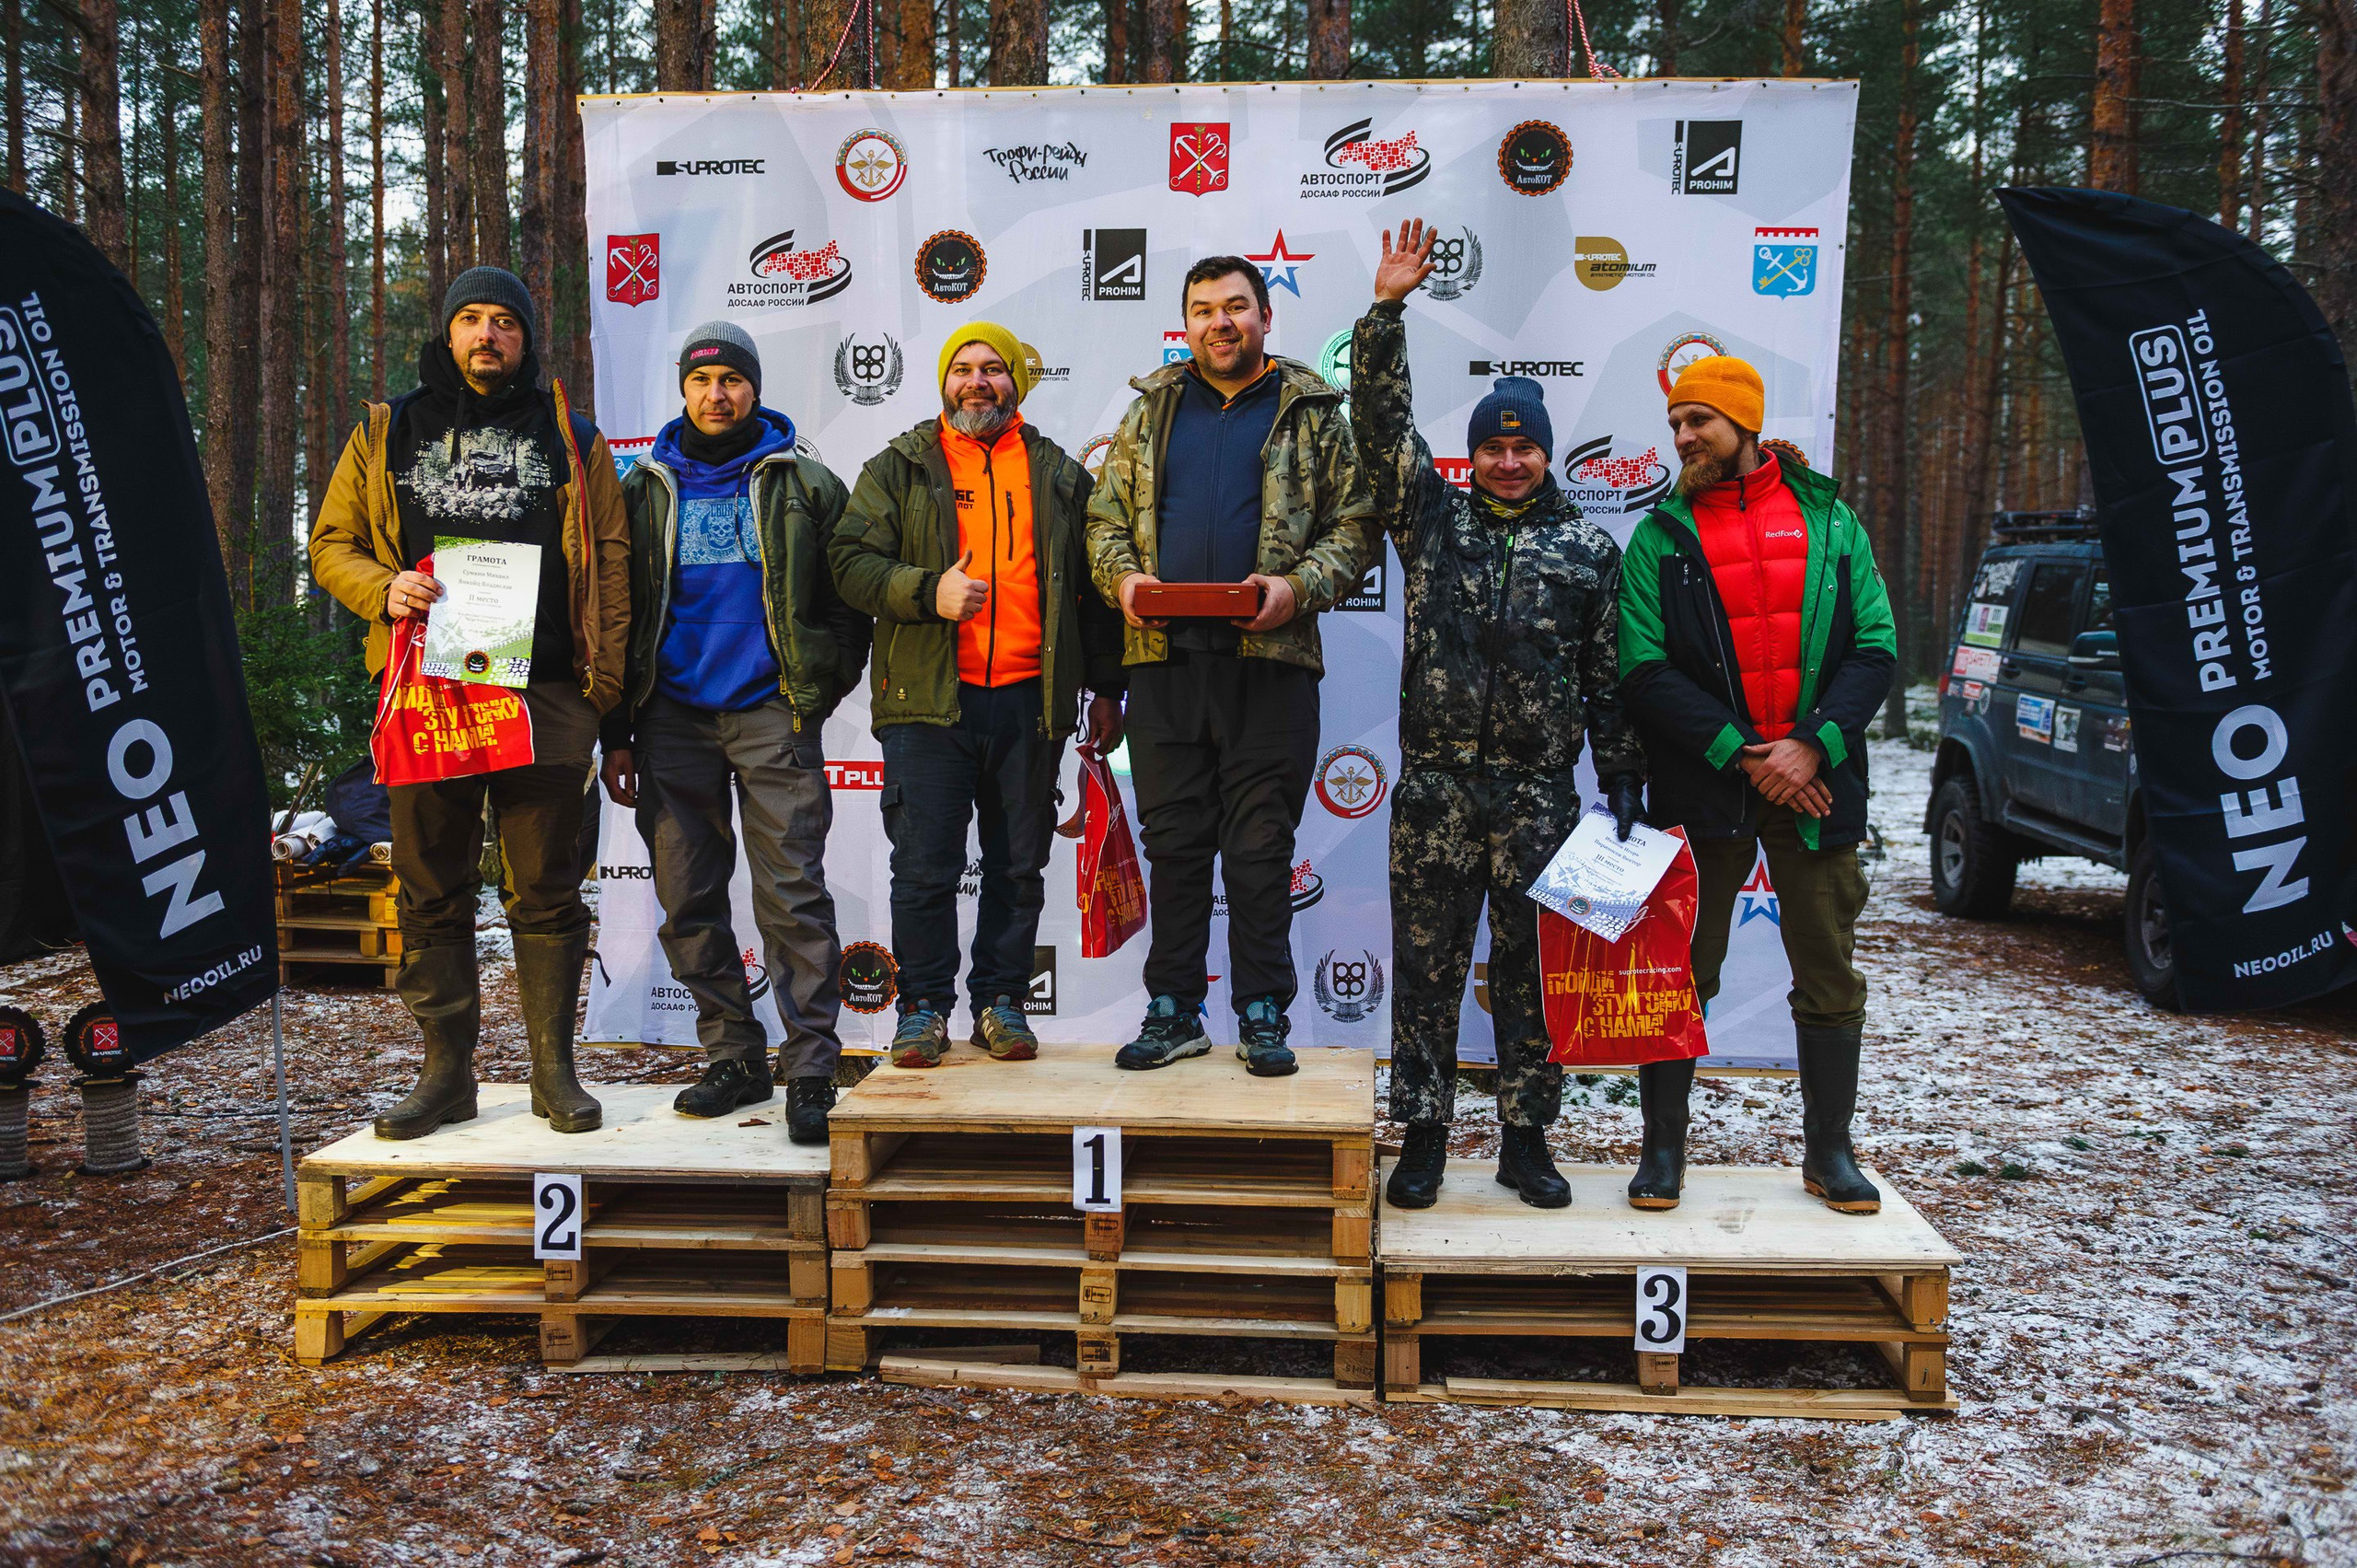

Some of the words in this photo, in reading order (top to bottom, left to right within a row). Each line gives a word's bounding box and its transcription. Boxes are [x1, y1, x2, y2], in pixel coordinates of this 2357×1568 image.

[983, 142, 1087, 168] Трофи-рейды
[671, 159, 765, 175] SUPROTEC
[1009, 160, 1068, 183] России
[1671, 141, 1683, 195] SUPROTEC
[1300, 173, 1381, 185] АВТОСПОРТ
[1516, 174, 1552, 184] АвтоКОТ
[1689, 180, 1733, 190] PROHIM
[1300, 190, 1340, 199] ДОСААФ
[1342, 190, 1381, 198] РОССИИ
[1082, 250, 1092, 301] SUPROTEC
[1590, 262, 1656, 272] atomium
[727, 283, 805, 295] АВТОСПОРТ
[934, 282, 968, 292] АвтоКОТ
[1098, 286, 1141, 296] PROHIM
[727, 299, 765, 308] ДОСААФ
[768, 298, 805, 307] РОССИИ
[21, 291, 52, 342] OIL
[2187, 308, 2214, 355] OIL
[1490, 361, 1584, 377] SUPROTEC
[2140, 335, 2199, 455] PLUS
[41, 348, 117, 569] TRANSMISSION
[2200, 359, 2253, 562] TRANSMISSION
[1583, 505, 1621, 515] РОССИИ
[1765, 530, 1794, 539] RedFox
[467, 554, 507, 565] ГРАМОТА
[104, 572, 123, 590] &
[2167, 466, 2237, 692] PREMIUM
[2236, 566, 2257, 582] &
[23, 465, 121, 712] PREMIUM
[1345, 598, 1381, 607] ROHIM
[2240, 585, 2272, 680] MOTOR
[110, 593, 148, 693] MOTOR
[2212, 703, 2310, 914] NEO
[107, 718, 226, 940] NEO
[2234, 930, 2335, 978] NEOOIL.RU
[163, 945, 263, 1005] NEOOIL.RU
[1619, 967, 1682, 976] suprotecracing.com
[651, 987, 691, 1000] АВТОС
[849, 993, 883, 1003] АвтоКОТ
[651, 1002, 686, 1011] ДОСААФ
[1024, 1002, 1051, 1011] OHIM
[1083, 1133, 1111, 1204] 1
[540, 1182, 576, 1251] 2
[1641, 1274, 1681, 1344] 3
